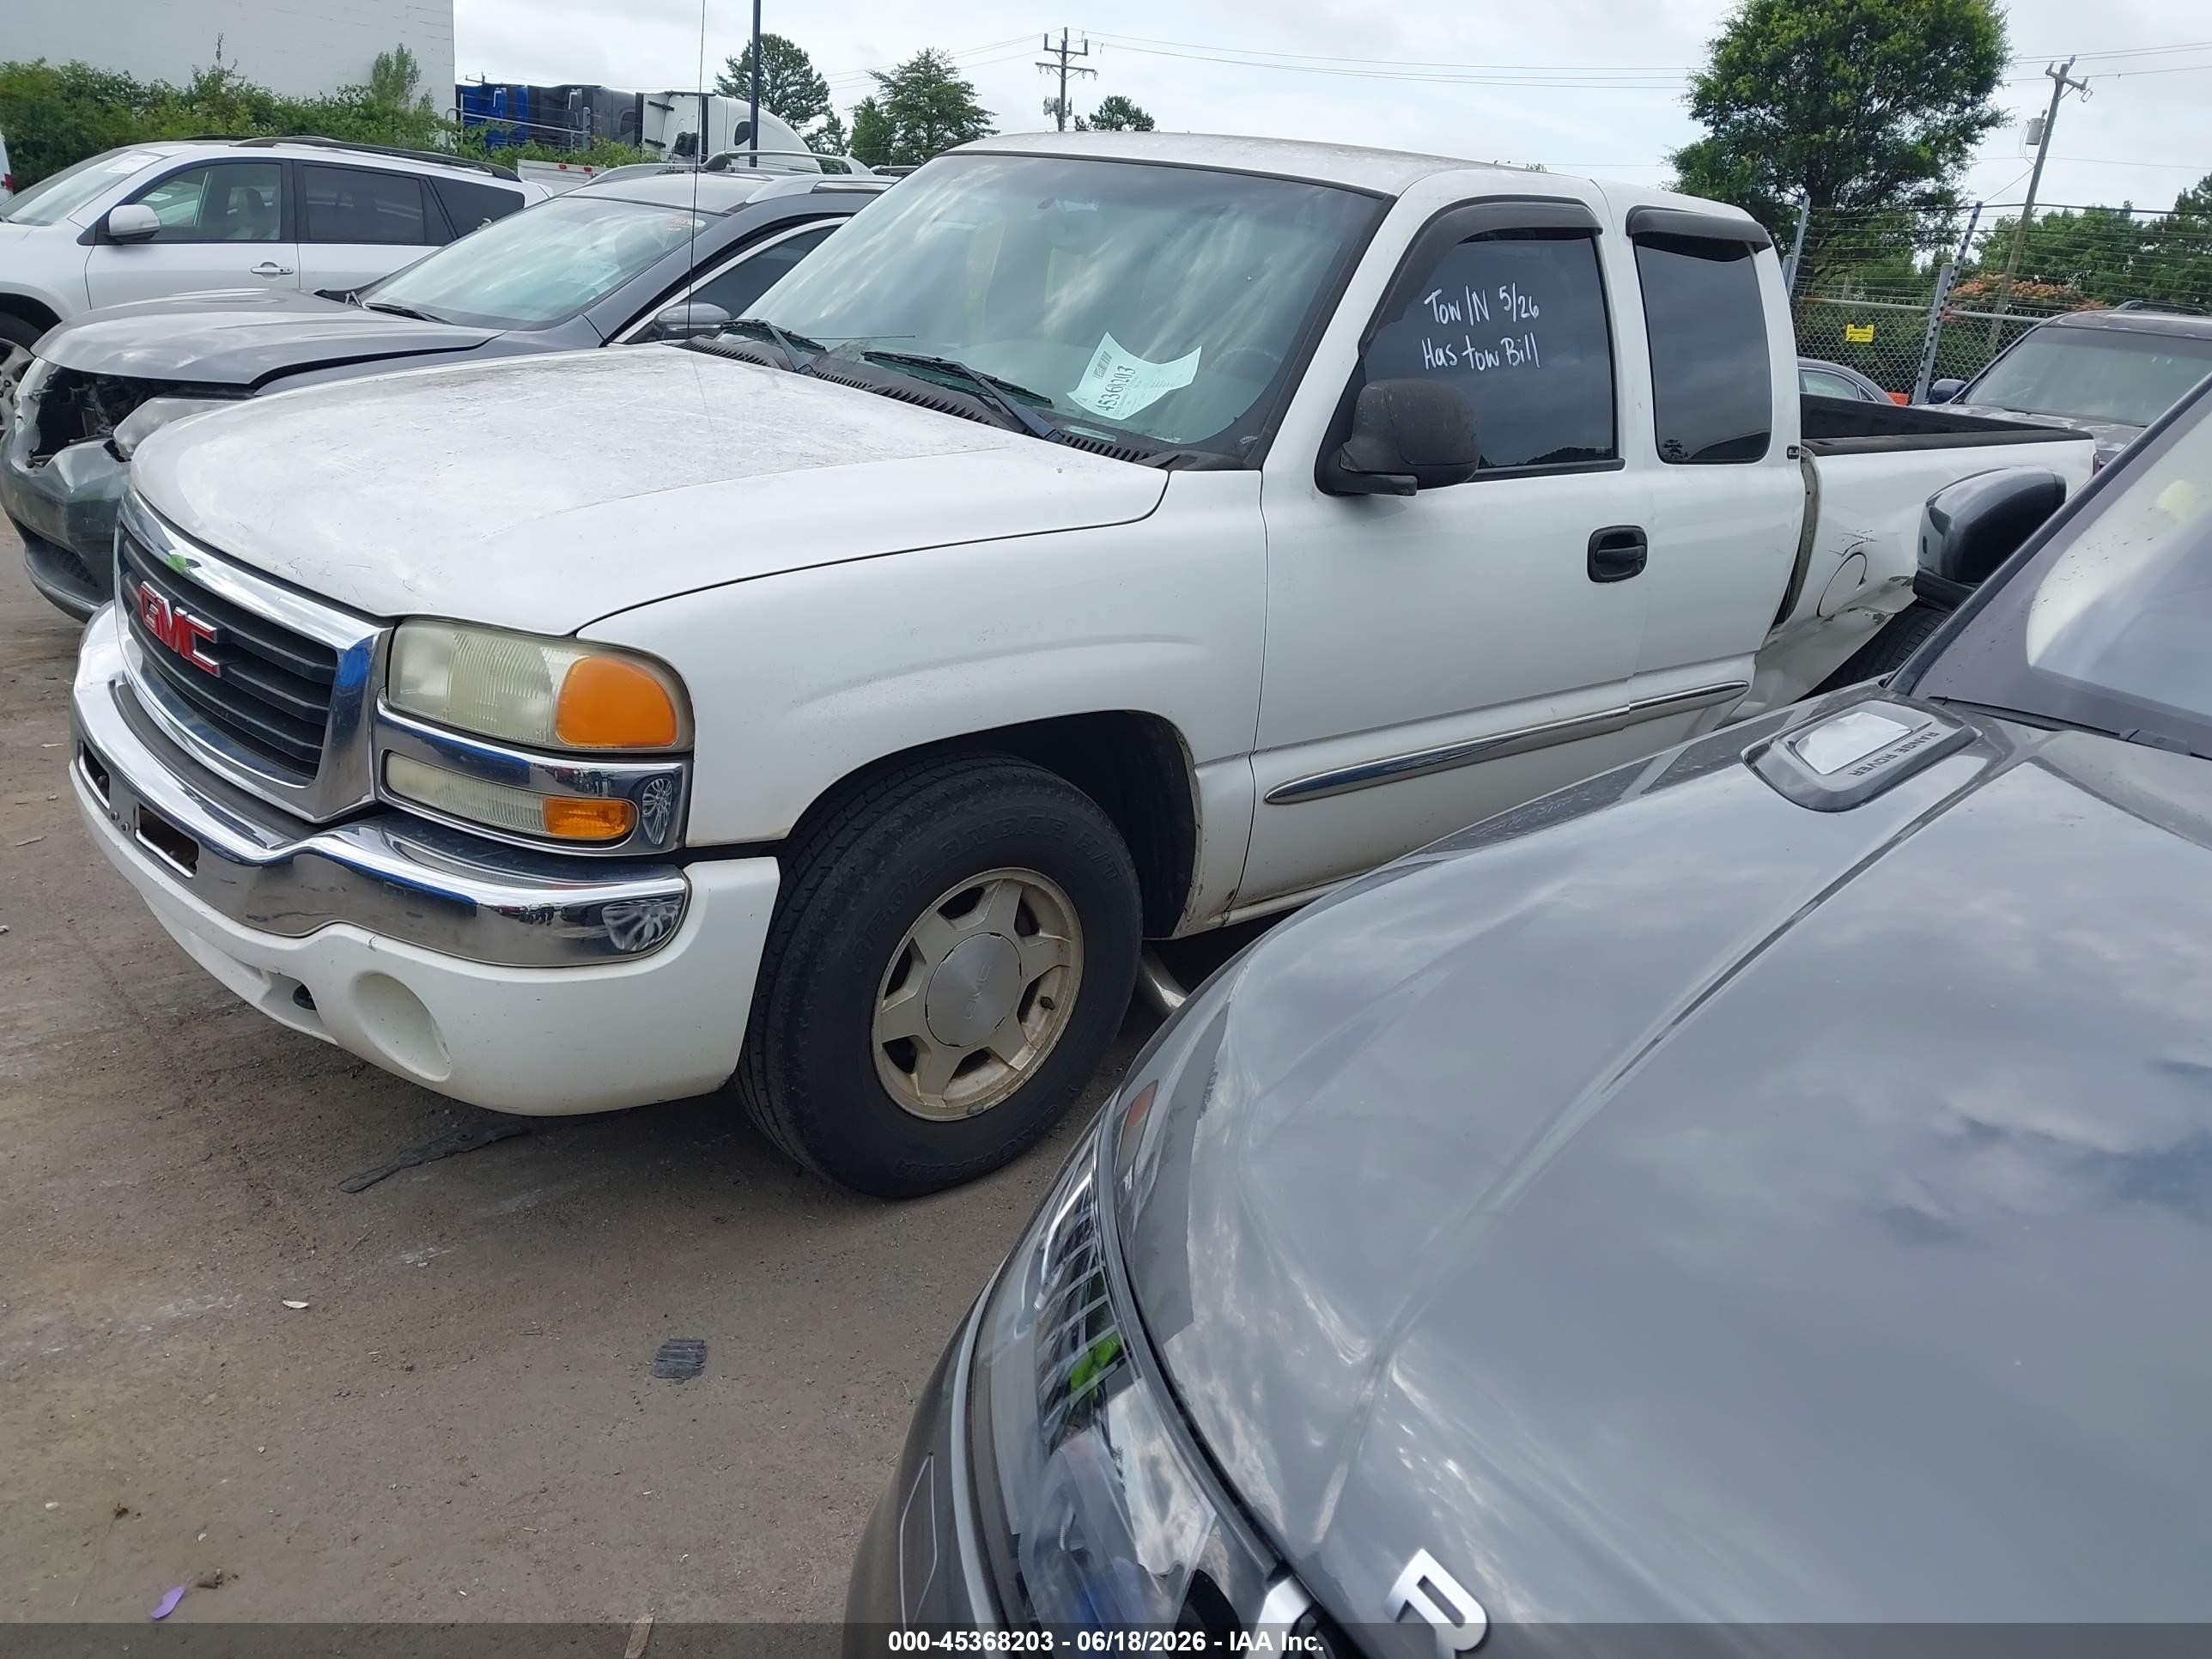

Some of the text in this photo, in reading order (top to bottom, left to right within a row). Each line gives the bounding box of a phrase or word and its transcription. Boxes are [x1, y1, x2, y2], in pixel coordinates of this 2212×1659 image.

[1423, 288, 1462, 325] Tow
[1498, 282, 1540, 323] 5/26
[1421, 337, 1458, 371] Has
[1500, 331, 1541, 369] Bill
[1095, 364, 1136, 411] 45368203
[139, 580, 221, 678] GMC
[1847, 732, 1941, 778] RANGE ROVER
